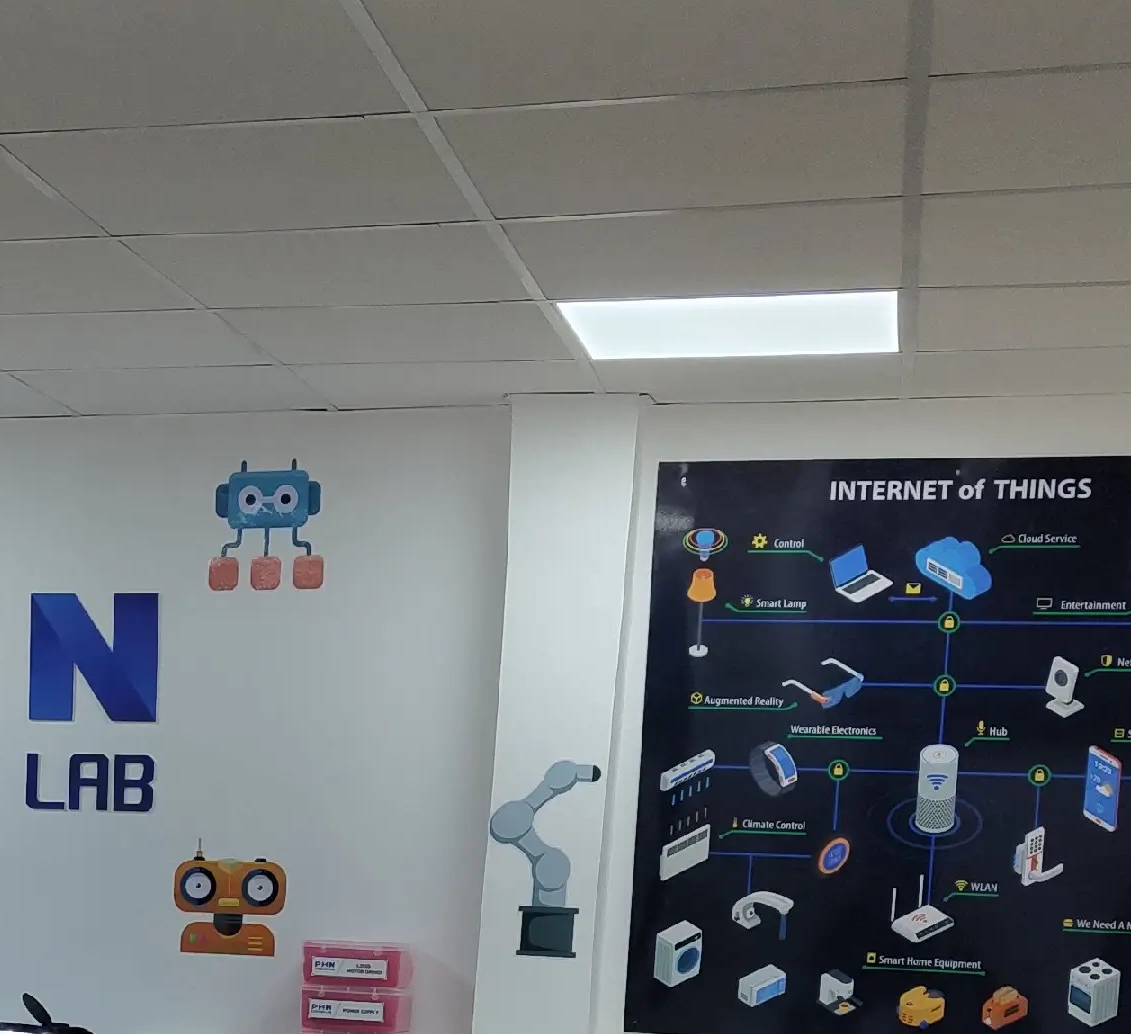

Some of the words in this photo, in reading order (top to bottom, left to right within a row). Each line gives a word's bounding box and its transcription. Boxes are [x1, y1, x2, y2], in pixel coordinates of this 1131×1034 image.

[829, 479, 954, 501] INTERNET
[958, 478, 987, 501] of
[993, 477, 1093, 500] THINGS
[773, 538, 805, 549] Control
[1018, 533, 1043, 543] Cloud
[1045, 533, 1078, 544] Service
[756, 598, 782, 609] Smart
[783, 599, 807, 610] Lamp
[1060, 600, 1127, 611] Entertainment
[704, 695, 753, 707] Augmented
[754, 696, 784, 708] Reality
[790, 724, 830, 735] Wearable
[831, 725, 877, 736] Electronics
[989, 726, 1008, 737] Hub
[25, 752, 155, 813] LAB
[742, 818, 774, 829] Climate
[775, 820, 806, 830] Control
[970, 881, 998, 892] WLAN
[1076, 918, 1091, 929] We
[1093, 919, 1117, 930] Need
[1117, 920, 1126, 930] A
[314, 960, 336, 968] PHN
[878, 955, 905, 966] Smart
[906, 956, 933, 967] Home
[934, 957, 982, 970] Equipment
